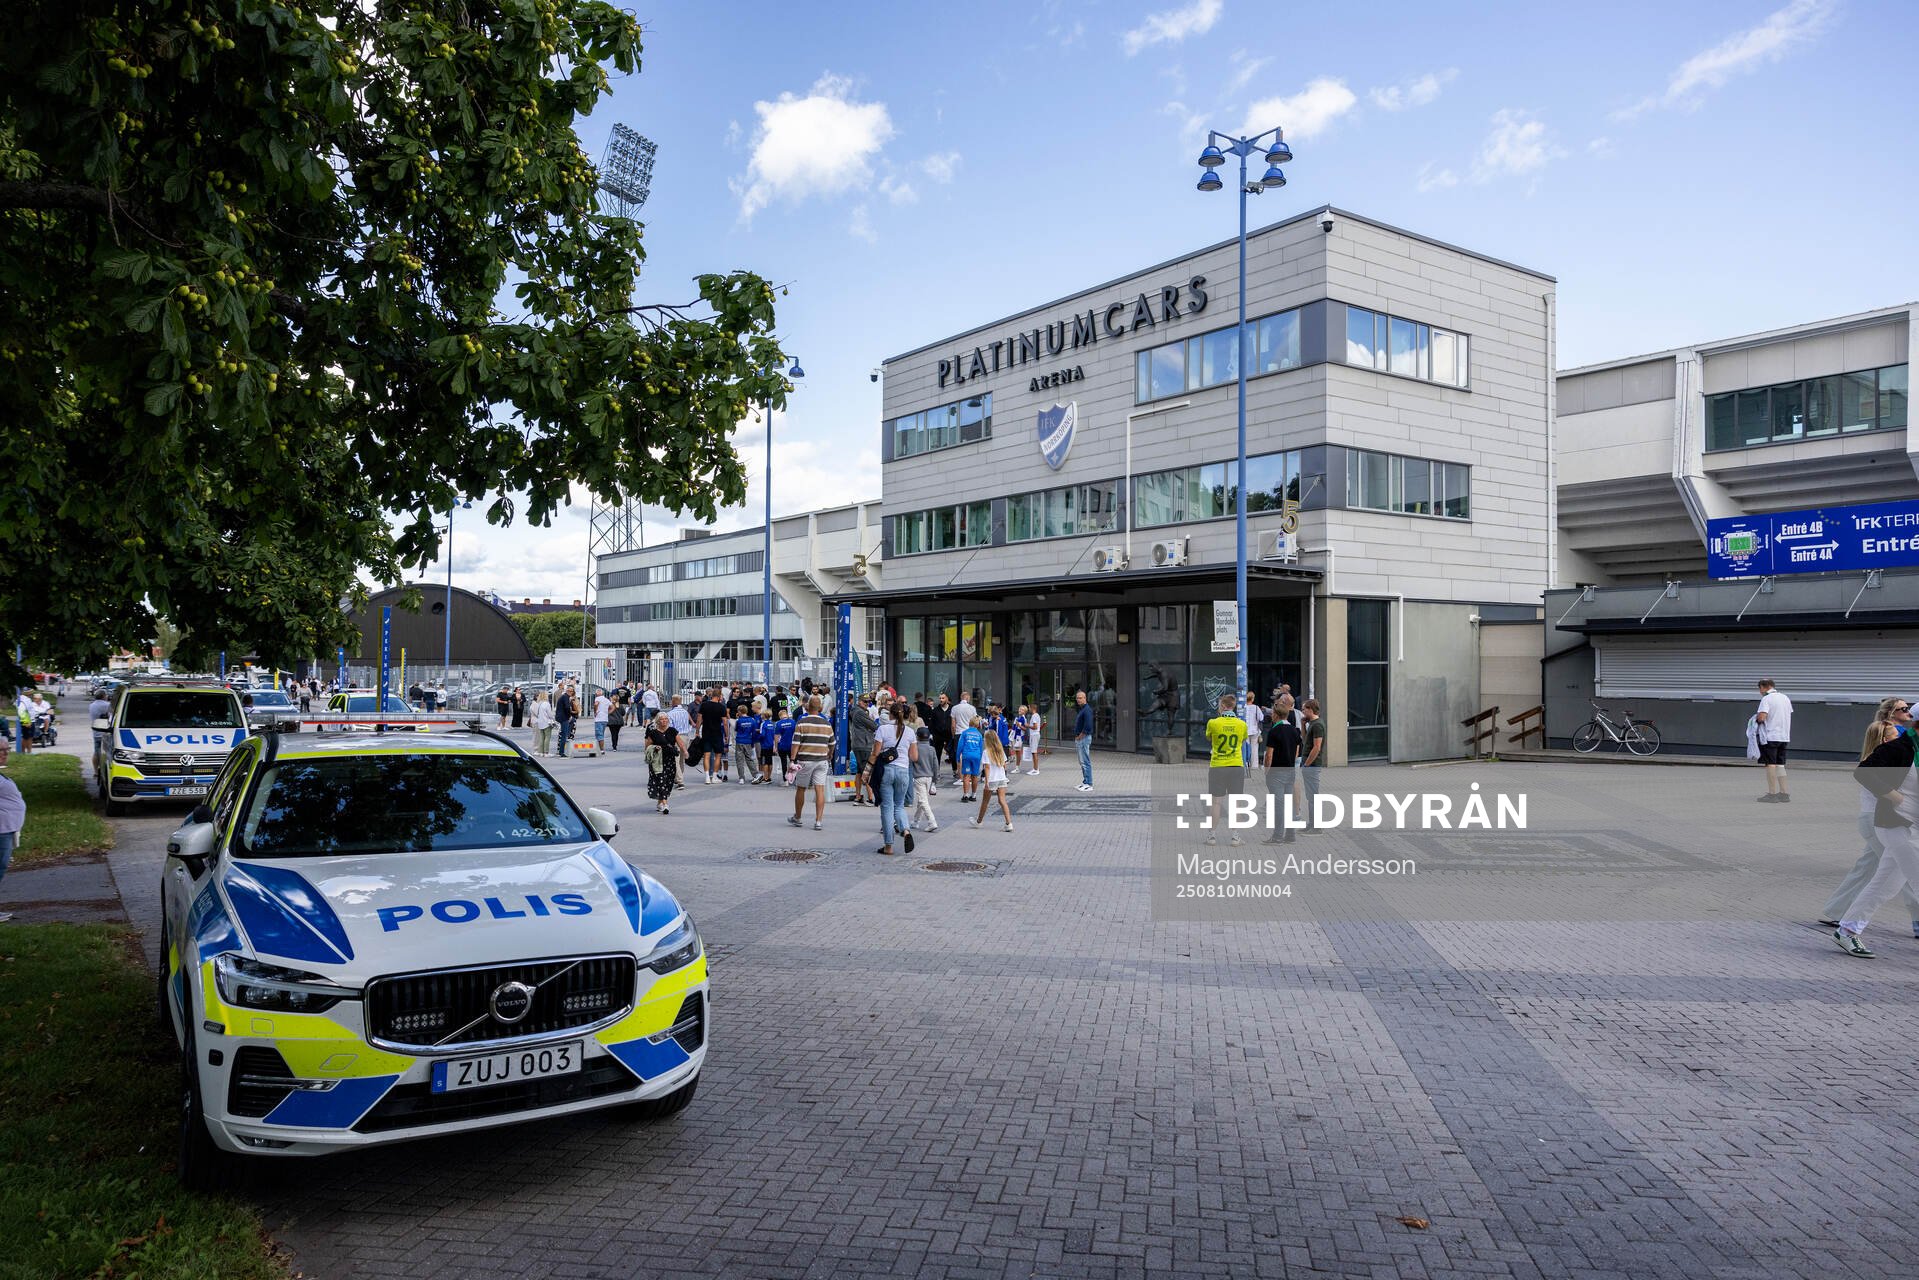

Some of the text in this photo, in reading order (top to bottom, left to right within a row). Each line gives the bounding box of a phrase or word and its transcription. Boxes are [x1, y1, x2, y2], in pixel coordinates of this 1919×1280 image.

[1029, 365, 1085, 392] ARENA
[1041, 416, 1056, 430] IFK
[1281, 499, 1299, 535] 5
[1781, 521, 1823, 536] Entré 4B
[1862, 534, 1919, 554] Entré
[1791, 548, 1833, 563] Entré 4A
[1216, 609, 1233, 617] Gunnar
[1216, 626, 1228, 634] plats
[146, 735, 225, 744] POLIS
[1217, 733, 1239, 754] 29
[511, 827, 570, 840] 42-2170
[376, 893, 593, 932] POLIS
[497, 998, 527, 1007] VOLVO
[458, 1047, 571, 1087] ZUJ 003
